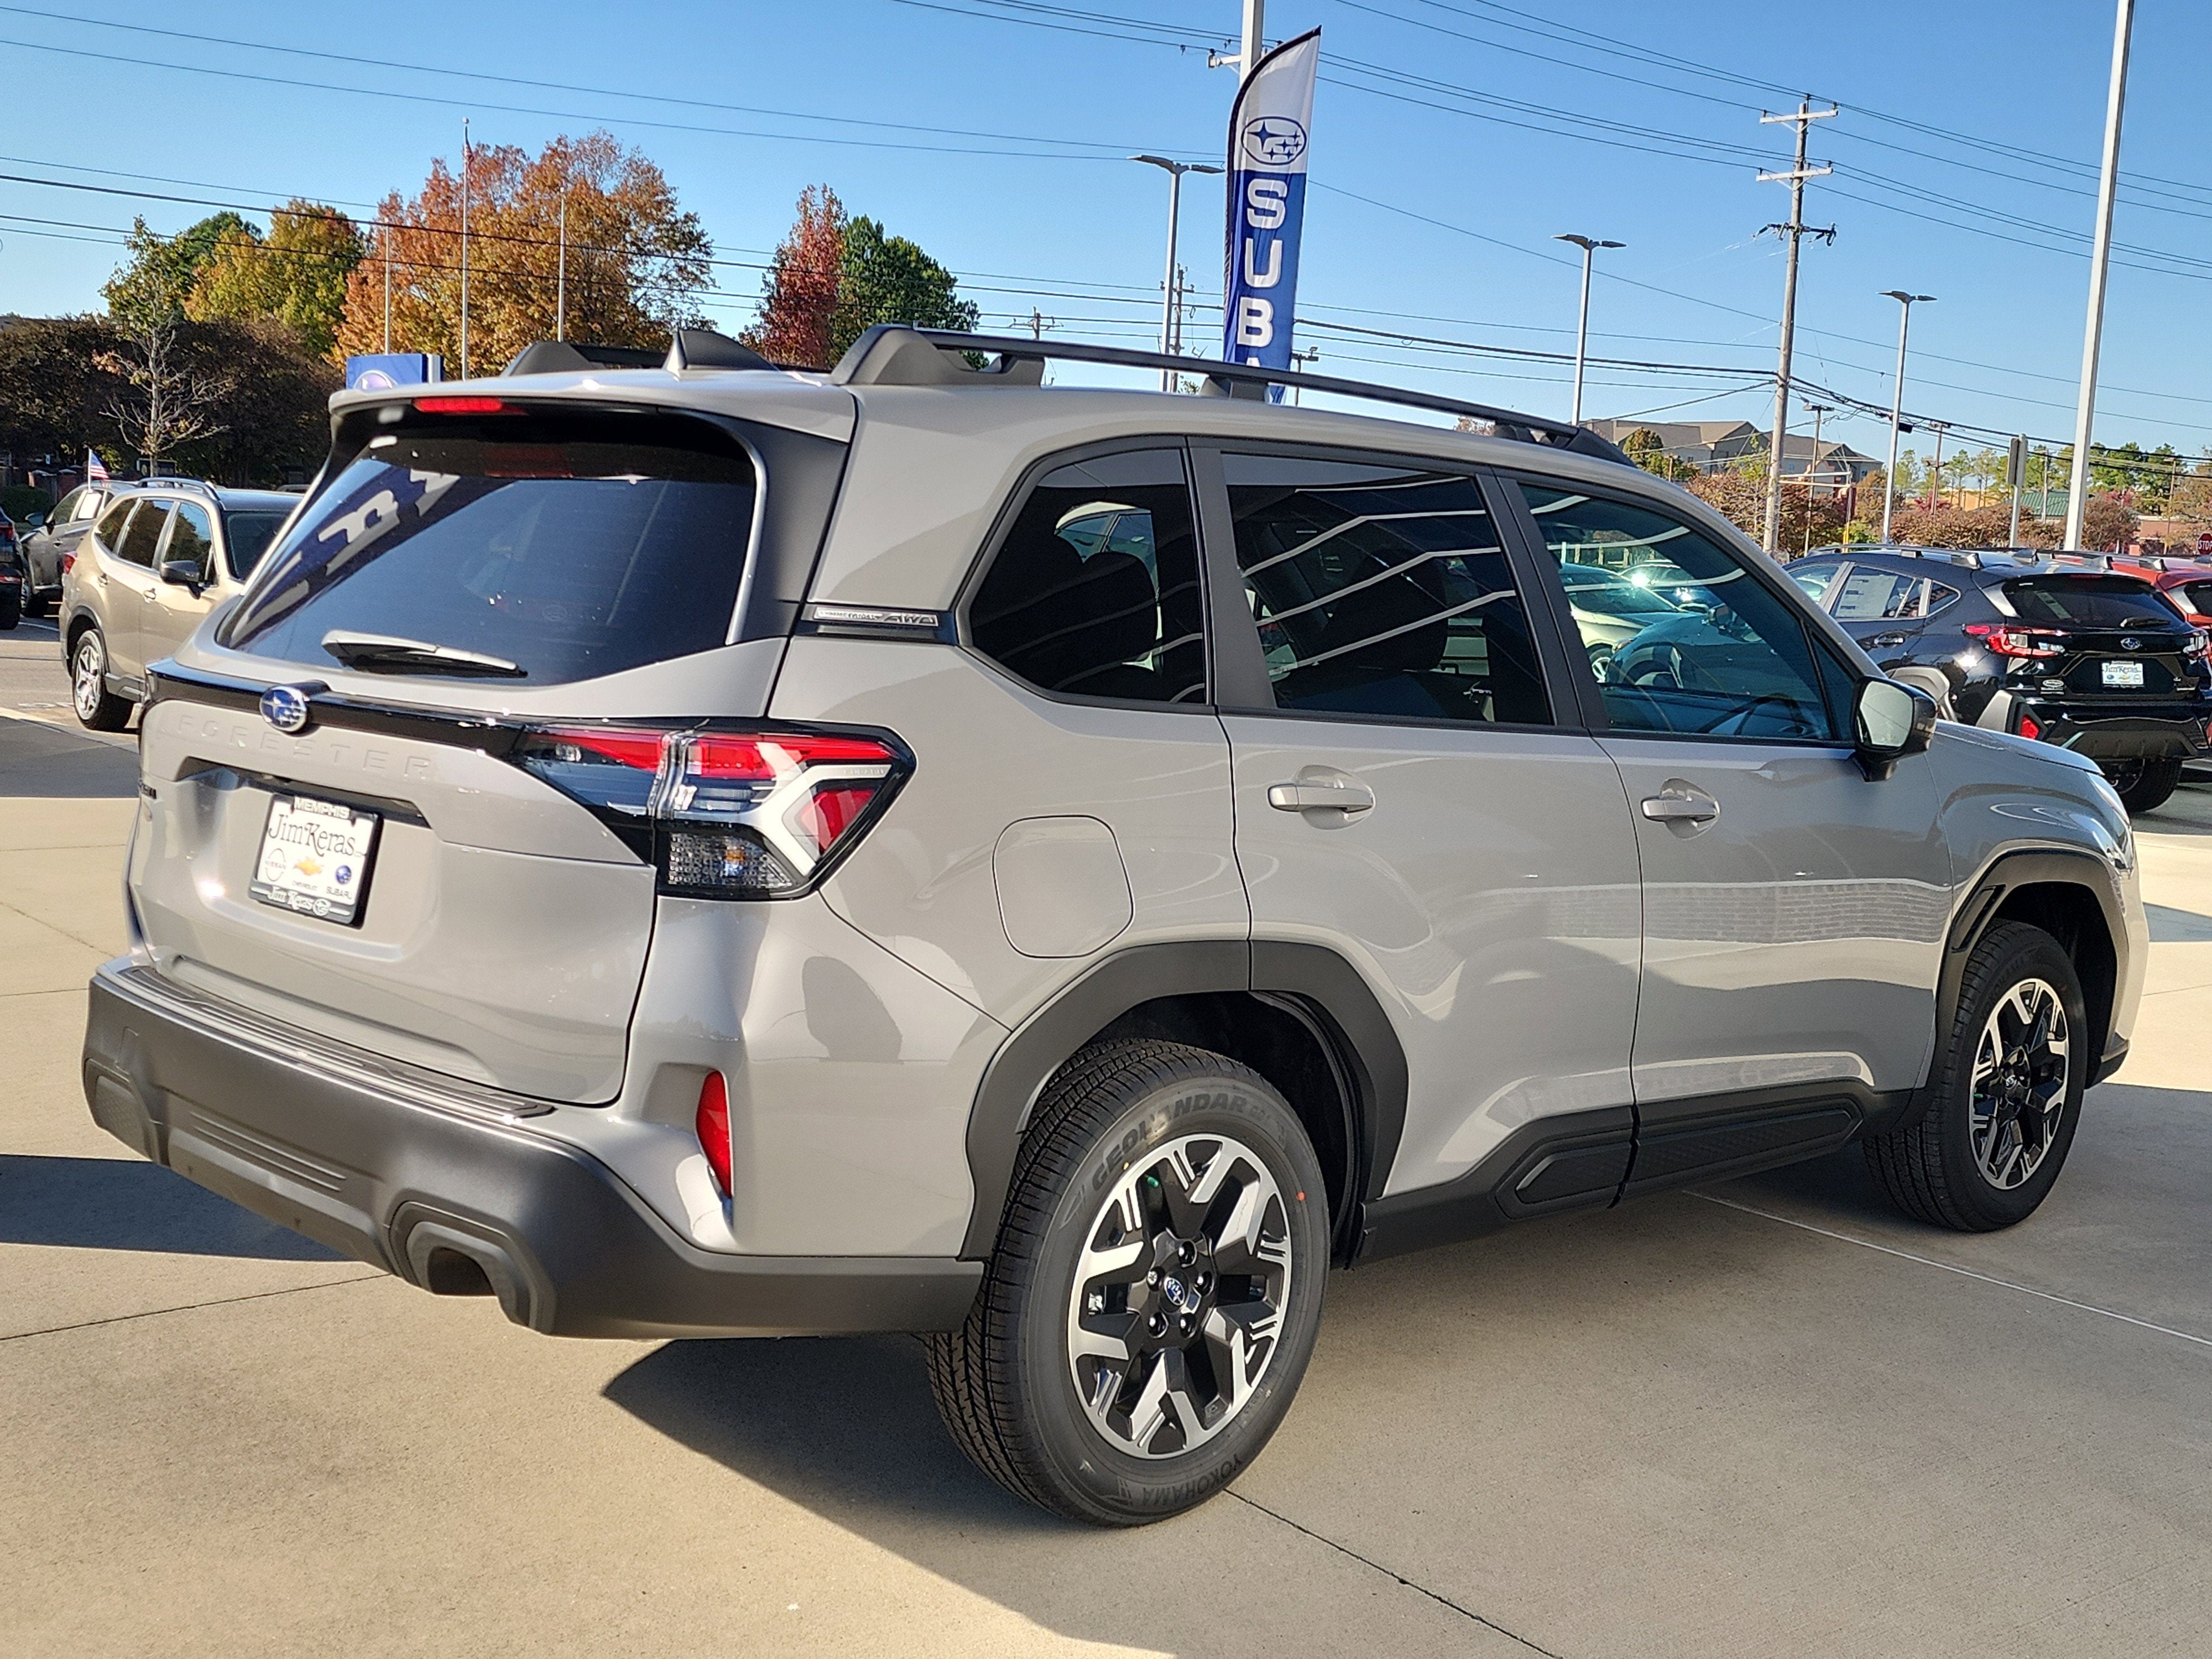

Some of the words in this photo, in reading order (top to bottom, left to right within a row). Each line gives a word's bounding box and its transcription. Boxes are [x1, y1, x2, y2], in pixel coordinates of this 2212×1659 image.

[1237, 178, 1288, 367] SUB
[176, 714, 432, 780] FORESTER
[295, 797, 350, 819] MEMPHIS
[1142, 1454, 1243, 1506] YOKOHAMA
